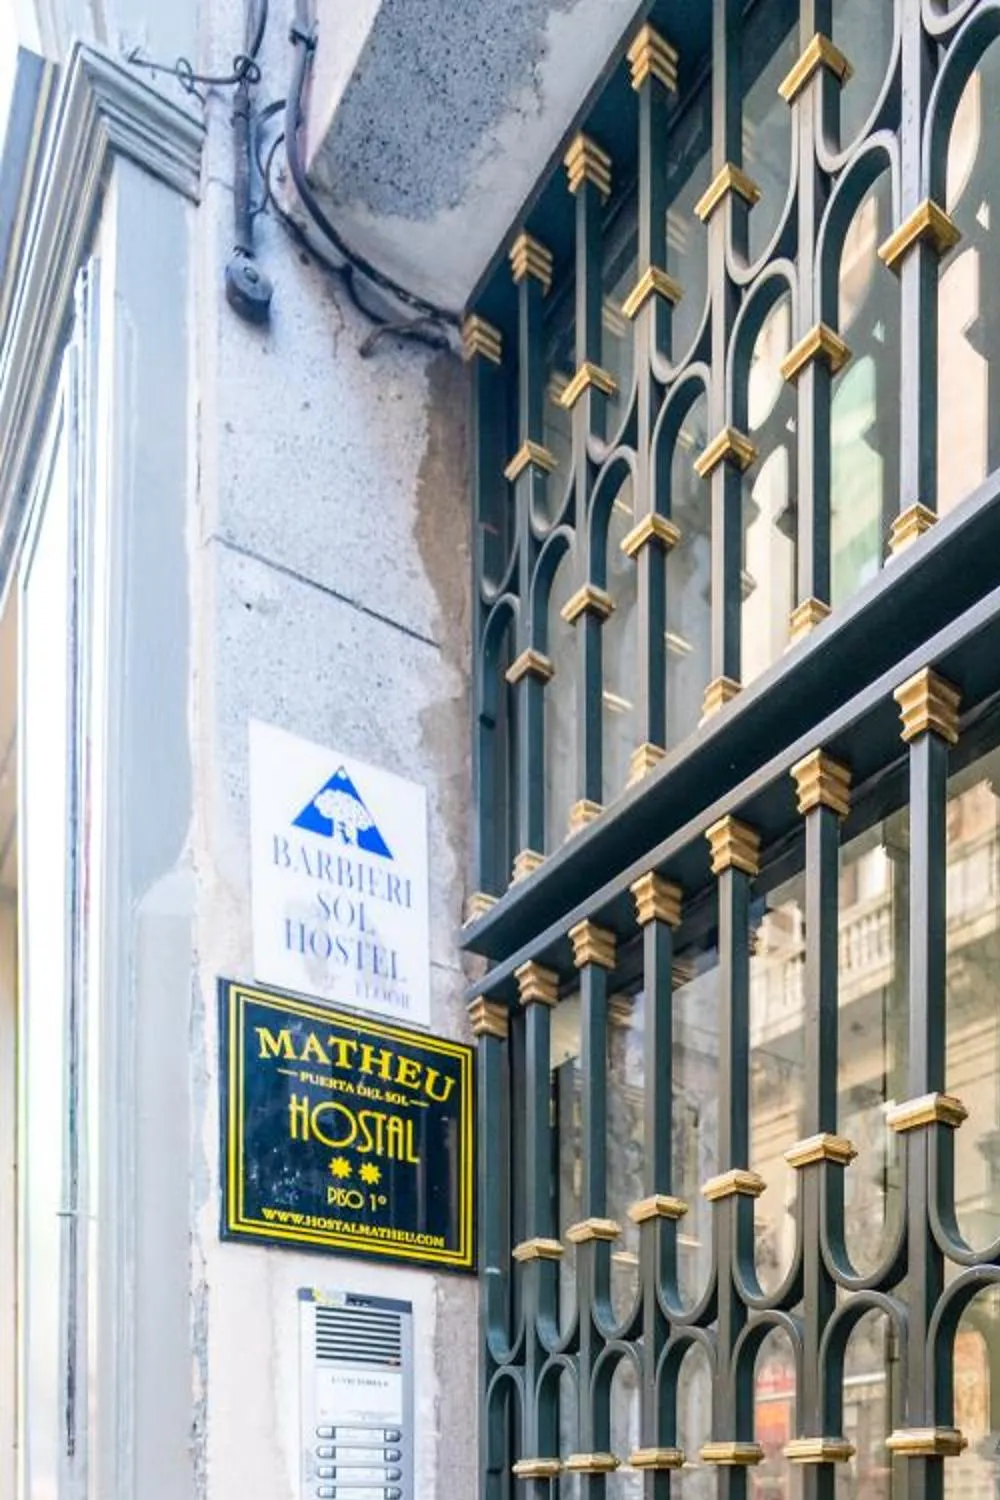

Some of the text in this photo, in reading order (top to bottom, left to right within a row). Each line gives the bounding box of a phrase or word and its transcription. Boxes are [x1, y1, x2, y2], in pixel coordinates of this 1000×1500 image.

[273, 834, 413, 908] BARBIERI
[317, 891, 376, 934] SOL
[284, 918, 407, 981] HOSTEL
[255, 1027, 456, 1103] MATHEU
[300, 1071, 411, 1107] PUERTA DEL SOL
[288, 1093, 420, 1164] HOSTAL
[327, 1186, 363, 1209] PISO
[261, 1207, 445, 1247] WWW.HOSTALMATHEU.COM
